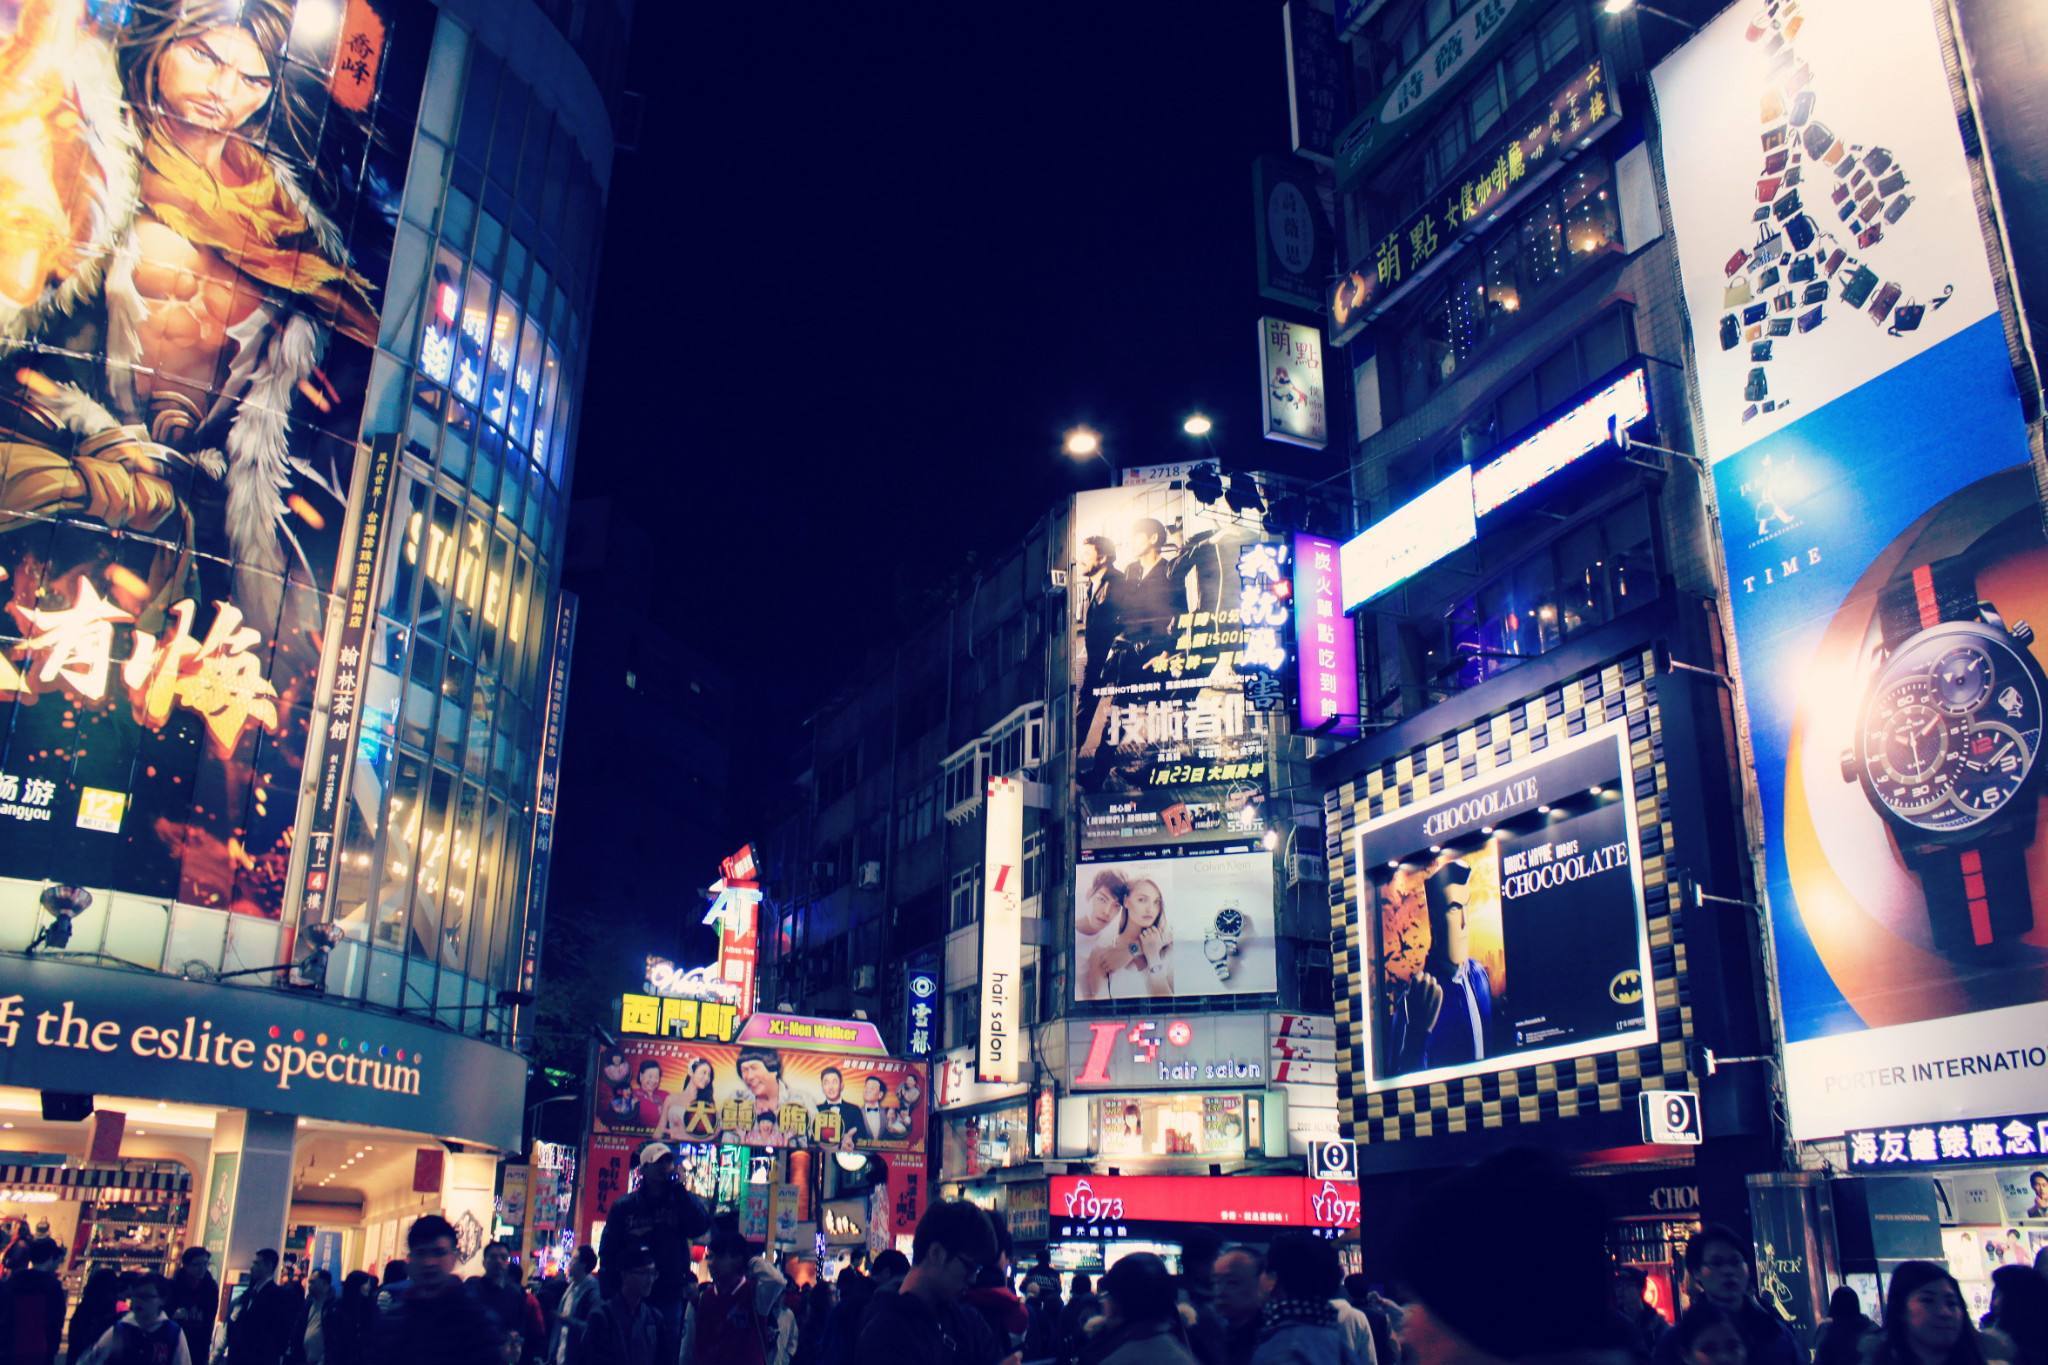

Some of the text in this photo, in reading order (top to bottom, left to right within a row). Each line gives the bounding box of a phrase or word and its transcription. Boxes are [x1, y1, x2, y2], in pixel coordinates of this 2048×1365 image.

[1742, 546, 1822, 594] TIME
[0, 574, 281, 755] 有悔
[329, 645, 361, 742] 翰林茶館
[1971, 736, 1995, 756] 12
[2000, 755, 2018, 773] 3
[1982, 786, 2000, 804] 6
[621, 992, 737, 1042] 西門町
[989, 972, 1008, 1062] hair salon
[36, 1001, 120, 1051] the
[131, 1016, 256, 1069] eslite
[262, 1041, 421, 1095] spectrum
[1159, 1059, 1262, 1081] hair salon
[1824, 1065, 1907, 1094] PORTER
[1079, 1195, 1125, 1225] 1973
